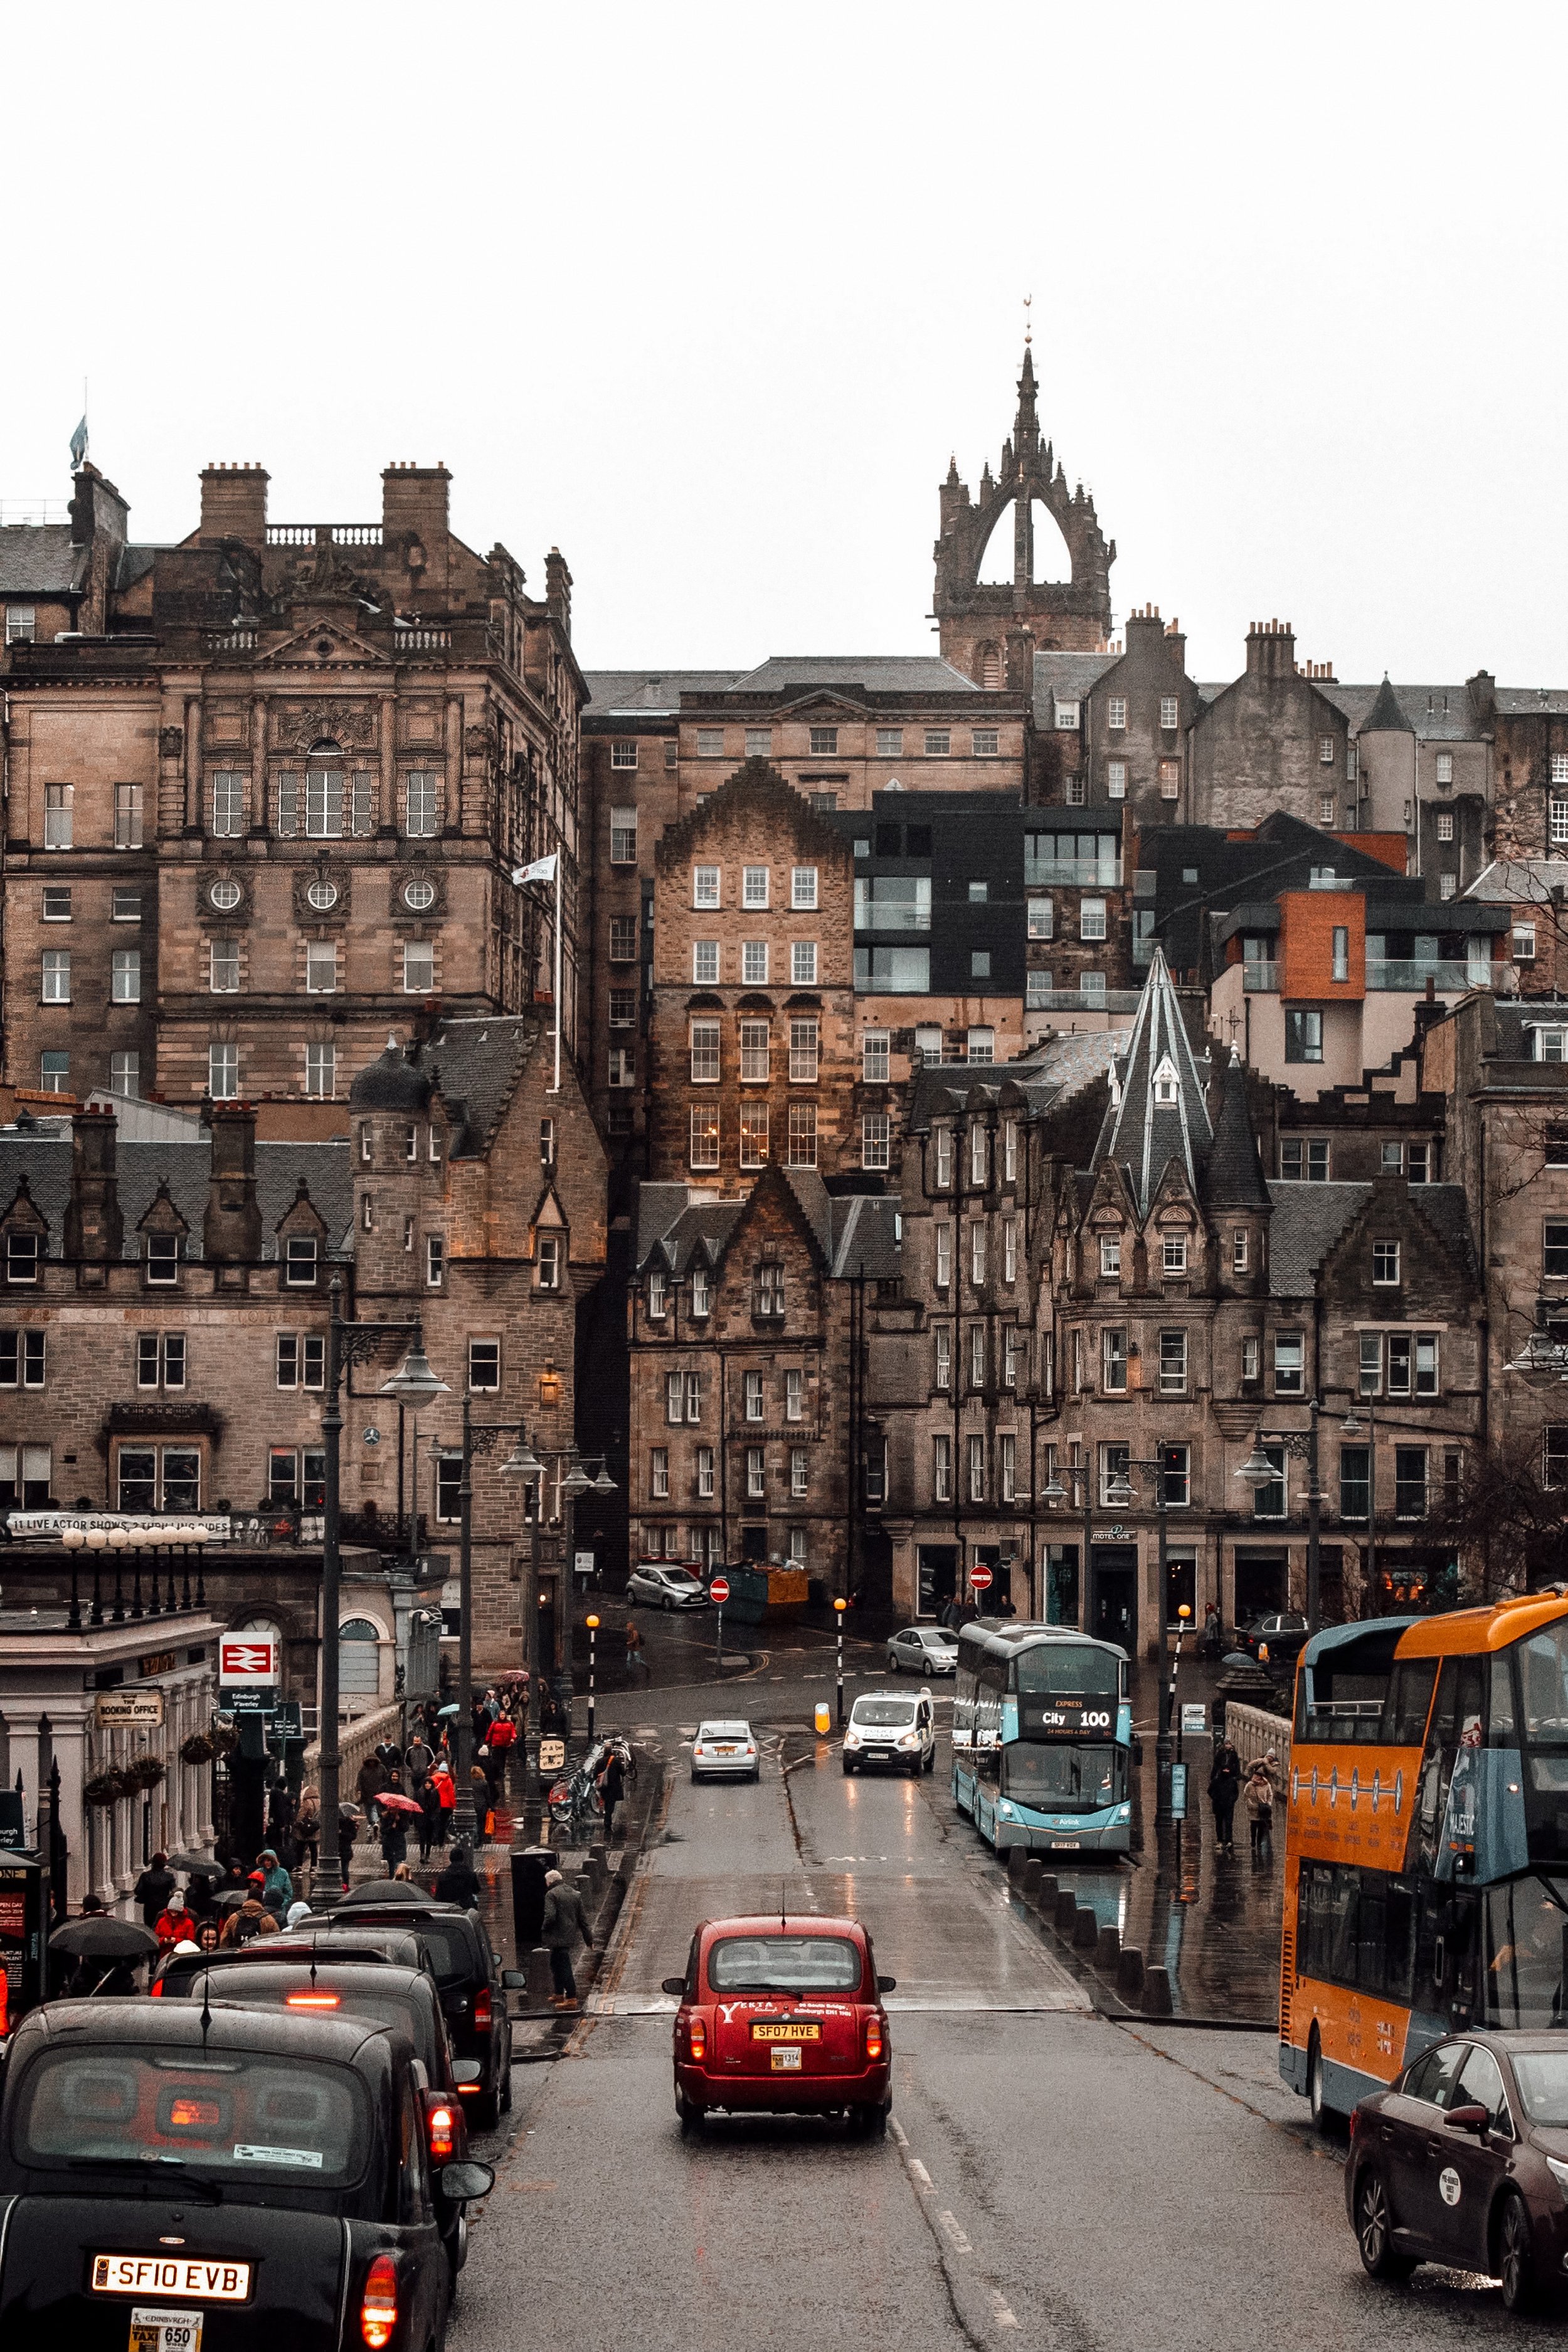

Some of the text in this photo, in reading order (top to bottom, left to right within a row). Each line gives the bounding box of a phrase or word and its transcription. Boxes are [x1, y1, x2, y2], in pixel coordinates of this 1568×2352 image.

[14, 1520, 23, 1528] 11
[27, 1520, 50, 1529] LIVE
[53, 1520, 87, 1530] ACTOR
[100, 1705, 158, 1715] BOOKING OFFICE
[1042, 1711, 1110, 1726] City 100
[1449, 1813, 1475, 1836] MAJESTIC
[718, 2001, 773, 2023] YEKTA
[758, 2026, 813, 2037] SF07 HVE
[785, 2053, 798, 2062] 1314
[119, 2261, 238, 2291] SF10 EVB
[132, 2331, 159, 2342] TAXI
[164, 2327, 190, 2343] 650
